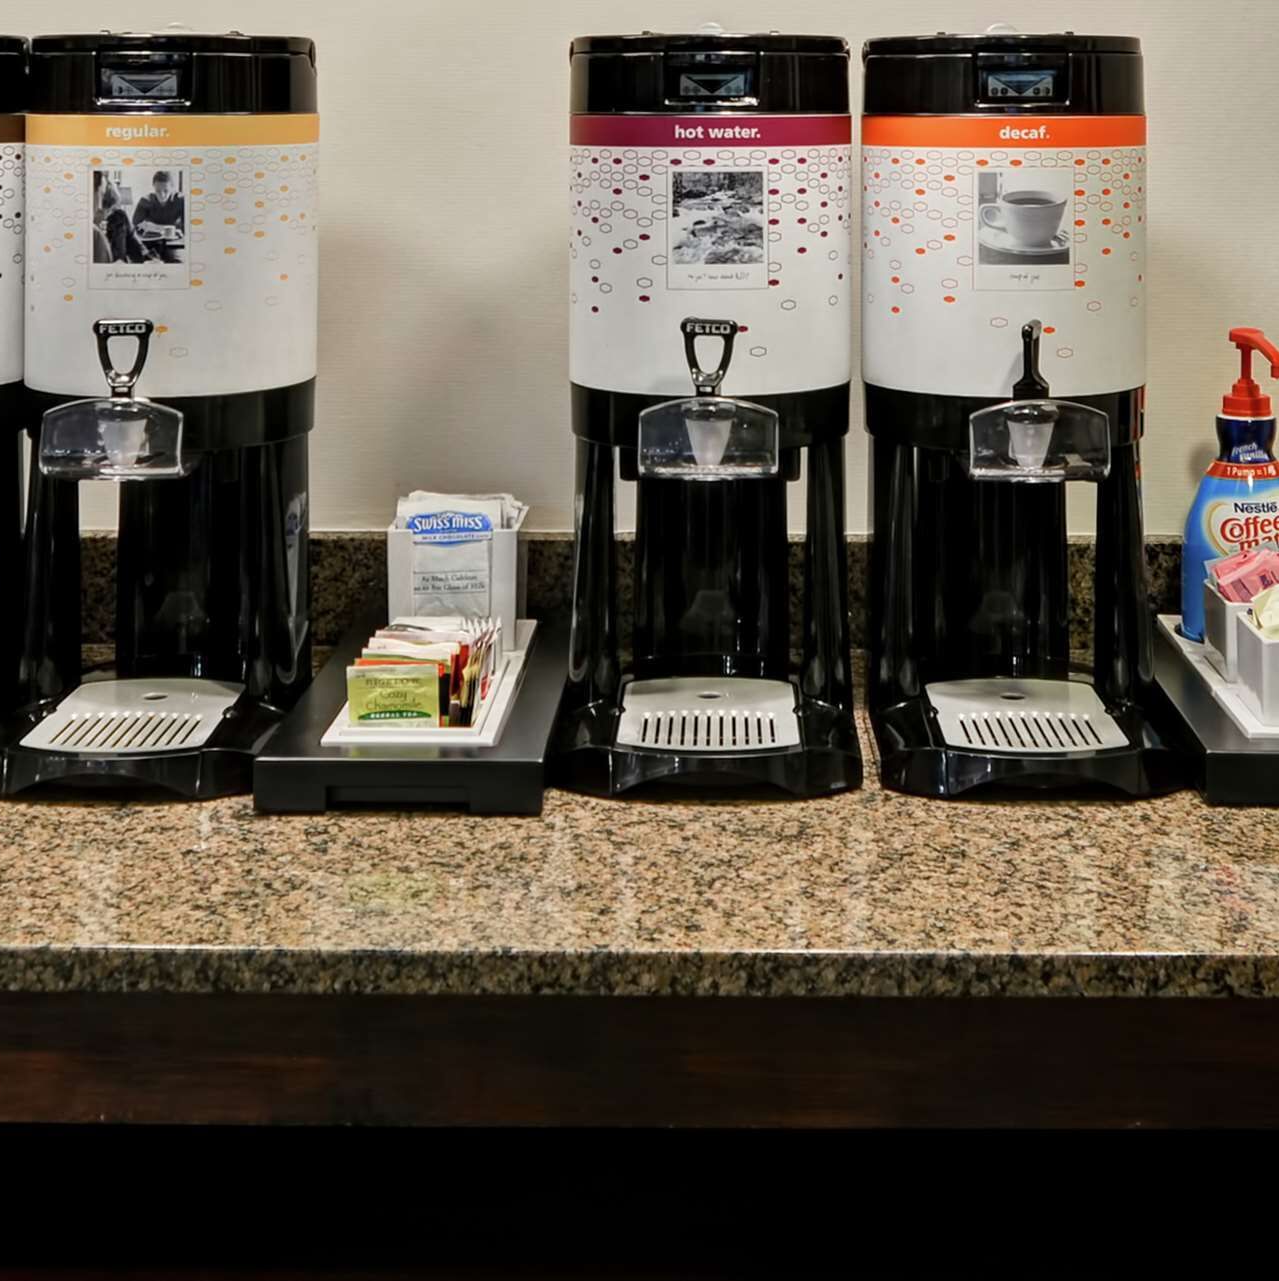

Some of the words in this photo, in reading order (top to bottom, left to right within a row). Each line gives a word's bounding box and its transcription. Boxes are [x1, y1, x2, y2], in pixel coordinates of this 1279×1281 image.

[105, 123, 171, 141] regular.
[674, 124, 704, 139] hot
[707, 125, 761, 139] water.
[999, 125, 1051, 140] decaf.
[99, 323, 147, 334] FETCO
[686, 323, 731, 334] FETCO
